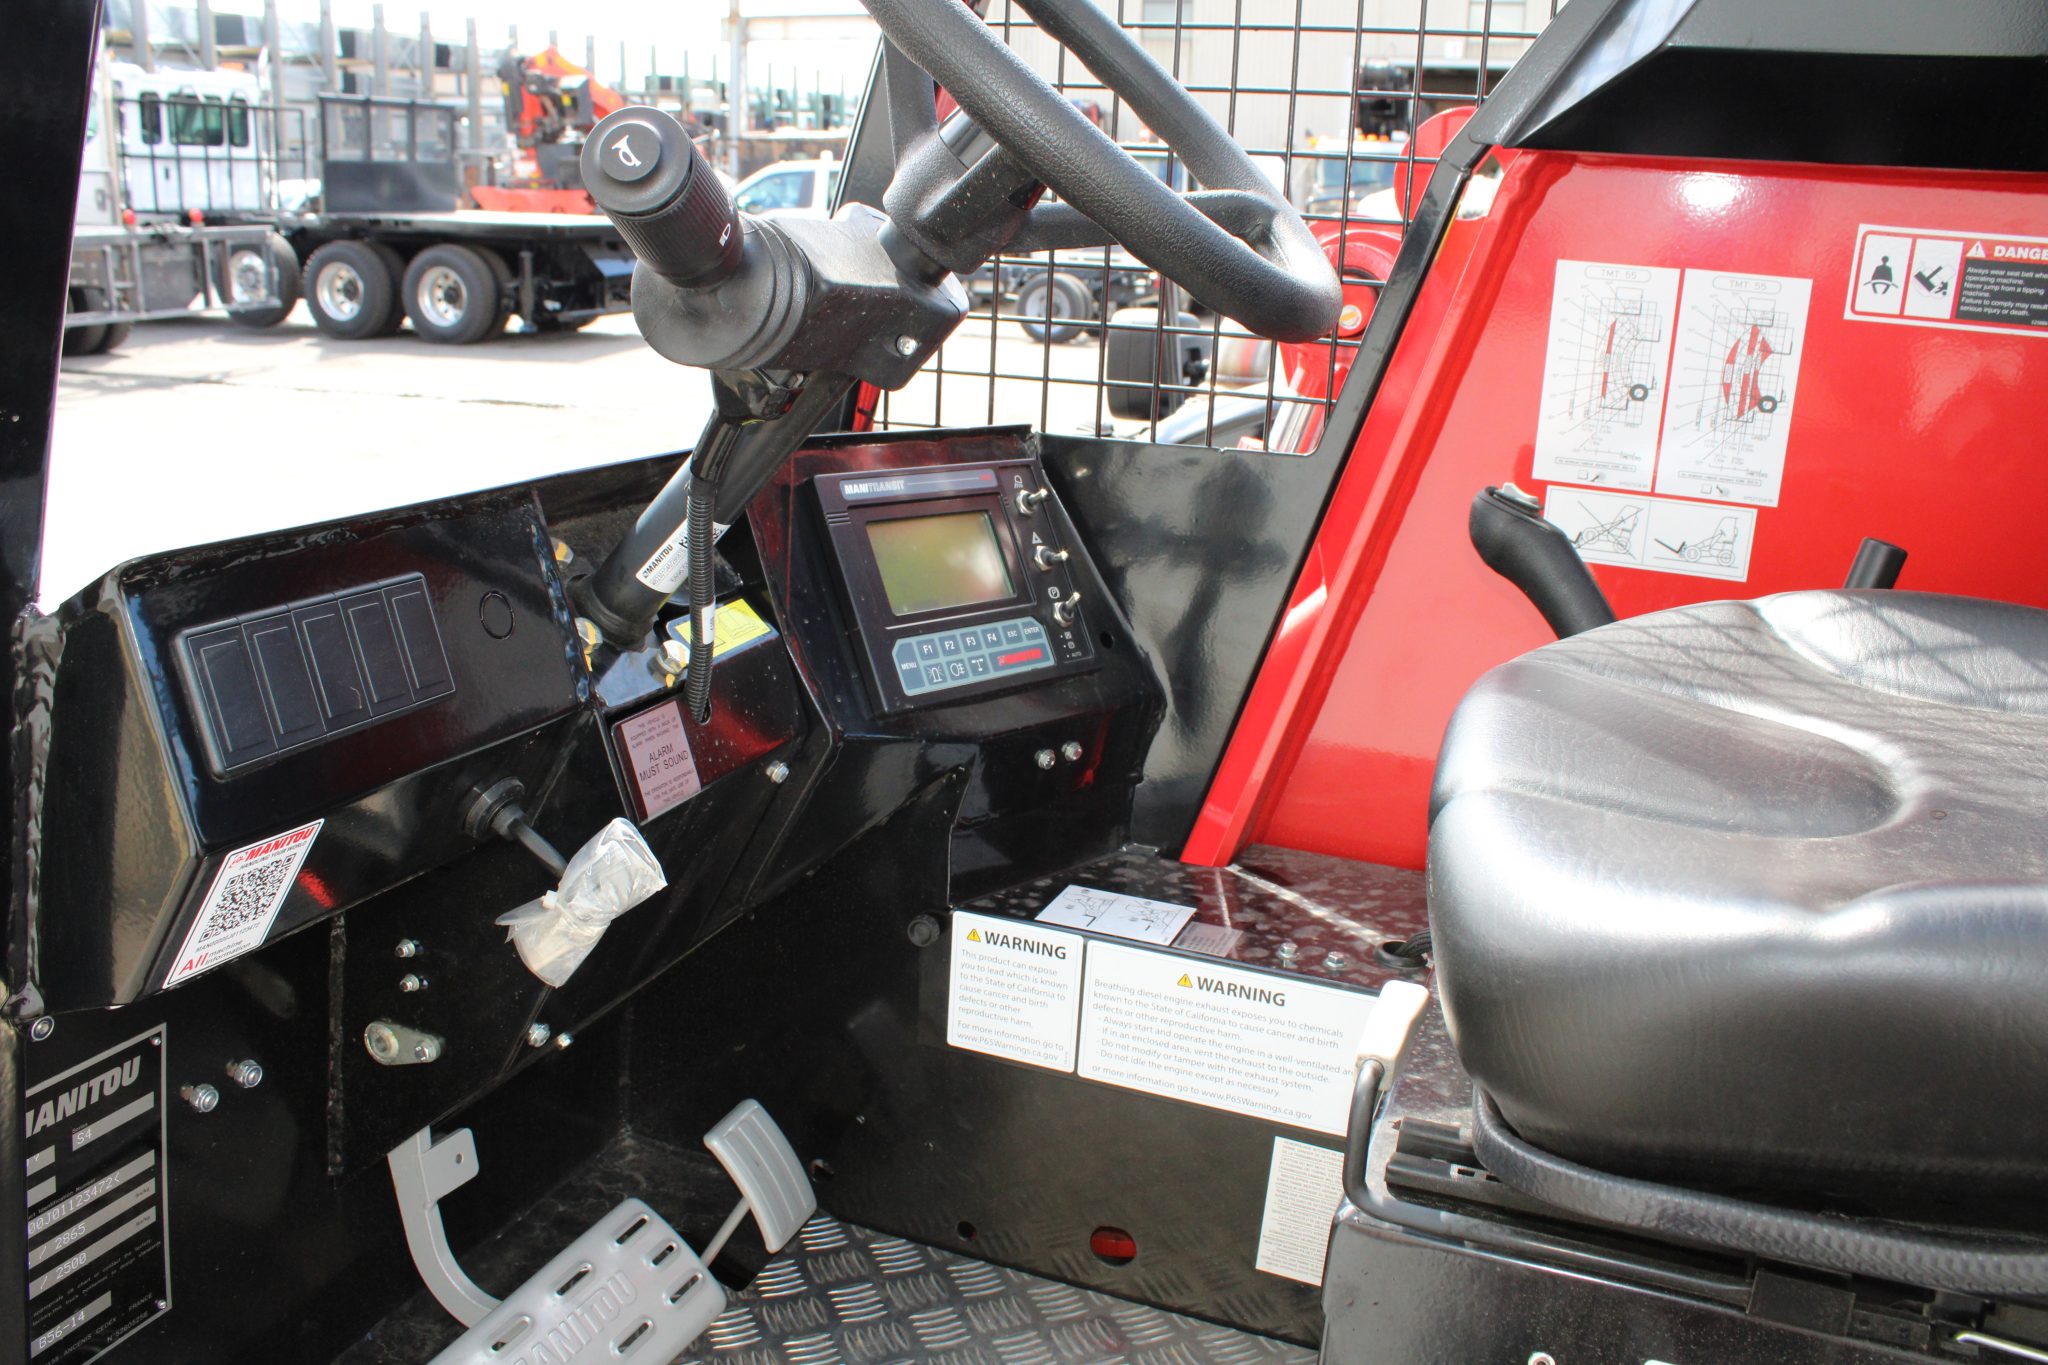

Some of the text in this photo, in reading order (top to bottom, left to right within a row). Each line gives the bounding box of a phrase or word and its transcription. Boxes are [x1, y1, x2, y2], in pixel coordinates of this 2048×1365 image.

[1600, 269, 1620, 278] TMT
[1728, 280, 1749, 289] TMT
[646, 544, 673, 574] MANITOU
[923, 645, 933, 654] F1
[945, 641, 955, 650] F2
[966, 637, 976, 646] F3
[986, 633, 997, 643] F4
[1024, 626, 1040, 635] ENTER
[901, 662, 917, 671] MENU
[639, 763, 660, 782] MUST
[664, 750, 689, 770] SOUND
[649, 744, 674, 763] ALARM
[246, 826, 315, 861] MANITOU
[984, 931, 1065, 959] WARNING
[178, 952, 209, 975] All
[960, 948, 1057, 976] This product can expose
[960, 961, 1068, 990] you to lead which is known
[959, 971, 1065, 1000] to the State of California to
[959, 984, 1048, 1008] cause cancer and birth
[1197, 976, 1284, 1006] WARNING
[958, 994, 987, 1006] defects
[998, 1003, 1020, 1013] other
[958, 1006, 1008, 1023] reproductive
[1094, 978, 1343, 1037] Breathing diesel engine exhaust exposes you to chemicals
[1092, 1002, 1122, 1015] defects
[1135, 1011, 1158, 1022] other
[1160, 1016, 1215, 1034] reproductive
[1093, 989, 1338, 1048] known to the State of California to cause cancer and birth
[957, 1019, 1064, 1051] For more information go to
[957, 1033, 1058, 1060] www.P65Warnings.ca.gov
[1103, 1015, 1132, 1029] Always
[1134, 1023, 1152, 1033] start
[1154, 1028, 1171, 1037] and
[1173, 1032, 1206, 1045] operate
[1208, 1038, 1222, 1048] the
[1224, 1043, 1255, 1055] engine
[1256, 1049, 1265, 1057] in
[1101, 1026, 1108, 1034] If
[1109, 1028, 1117, 1037] in
[1131, 1035, 1169, 1048] enclosed
[1193, 1048, 1212, 1058] vent
[1214, 1051, 1229, 1061] the
[1231, 1056, 1265, 1069] exhaust
[1266, 1062, 1276, 1073] to
[1278, 1065, 1293, 1075] the
[1101, 1037, 1113, 1047] Do
[1115, 1042, 1130, 1051] not
[1131, 1046, 1161, 1059] modify
[1174, 1054, 1204, 1067] tamper
[1206, 1062, 1226, 1072] with
[1228, 1064, 1242, 1077] the
[1244, 1071, 1278, 1084] exhaust
[1100, 1049, 1112, 1058] Do
[1114, 1053, 1128, 1063] not
[1130, 1055, 1146, 1066] idle
[1148, 1060, 1162, 1070] the
[1163, 1065, 1193, 1076] engine
[1194, 1072, 1223, 1084] except
[1102, 1067, 1124, 1078] more
[1126, 1072, 1174, 1088] information
[1176, 1084, 1188, 1092] go
[1190, 1086, 1199, 1095] to
[1201, 1090, 1311, 1119] www.P65Warnings.ca.gov
[76, 1128, 92, 1145] S4
[55, 1222, 86, 1250] 2865
[56, 1252, 87, 1279] 2500
